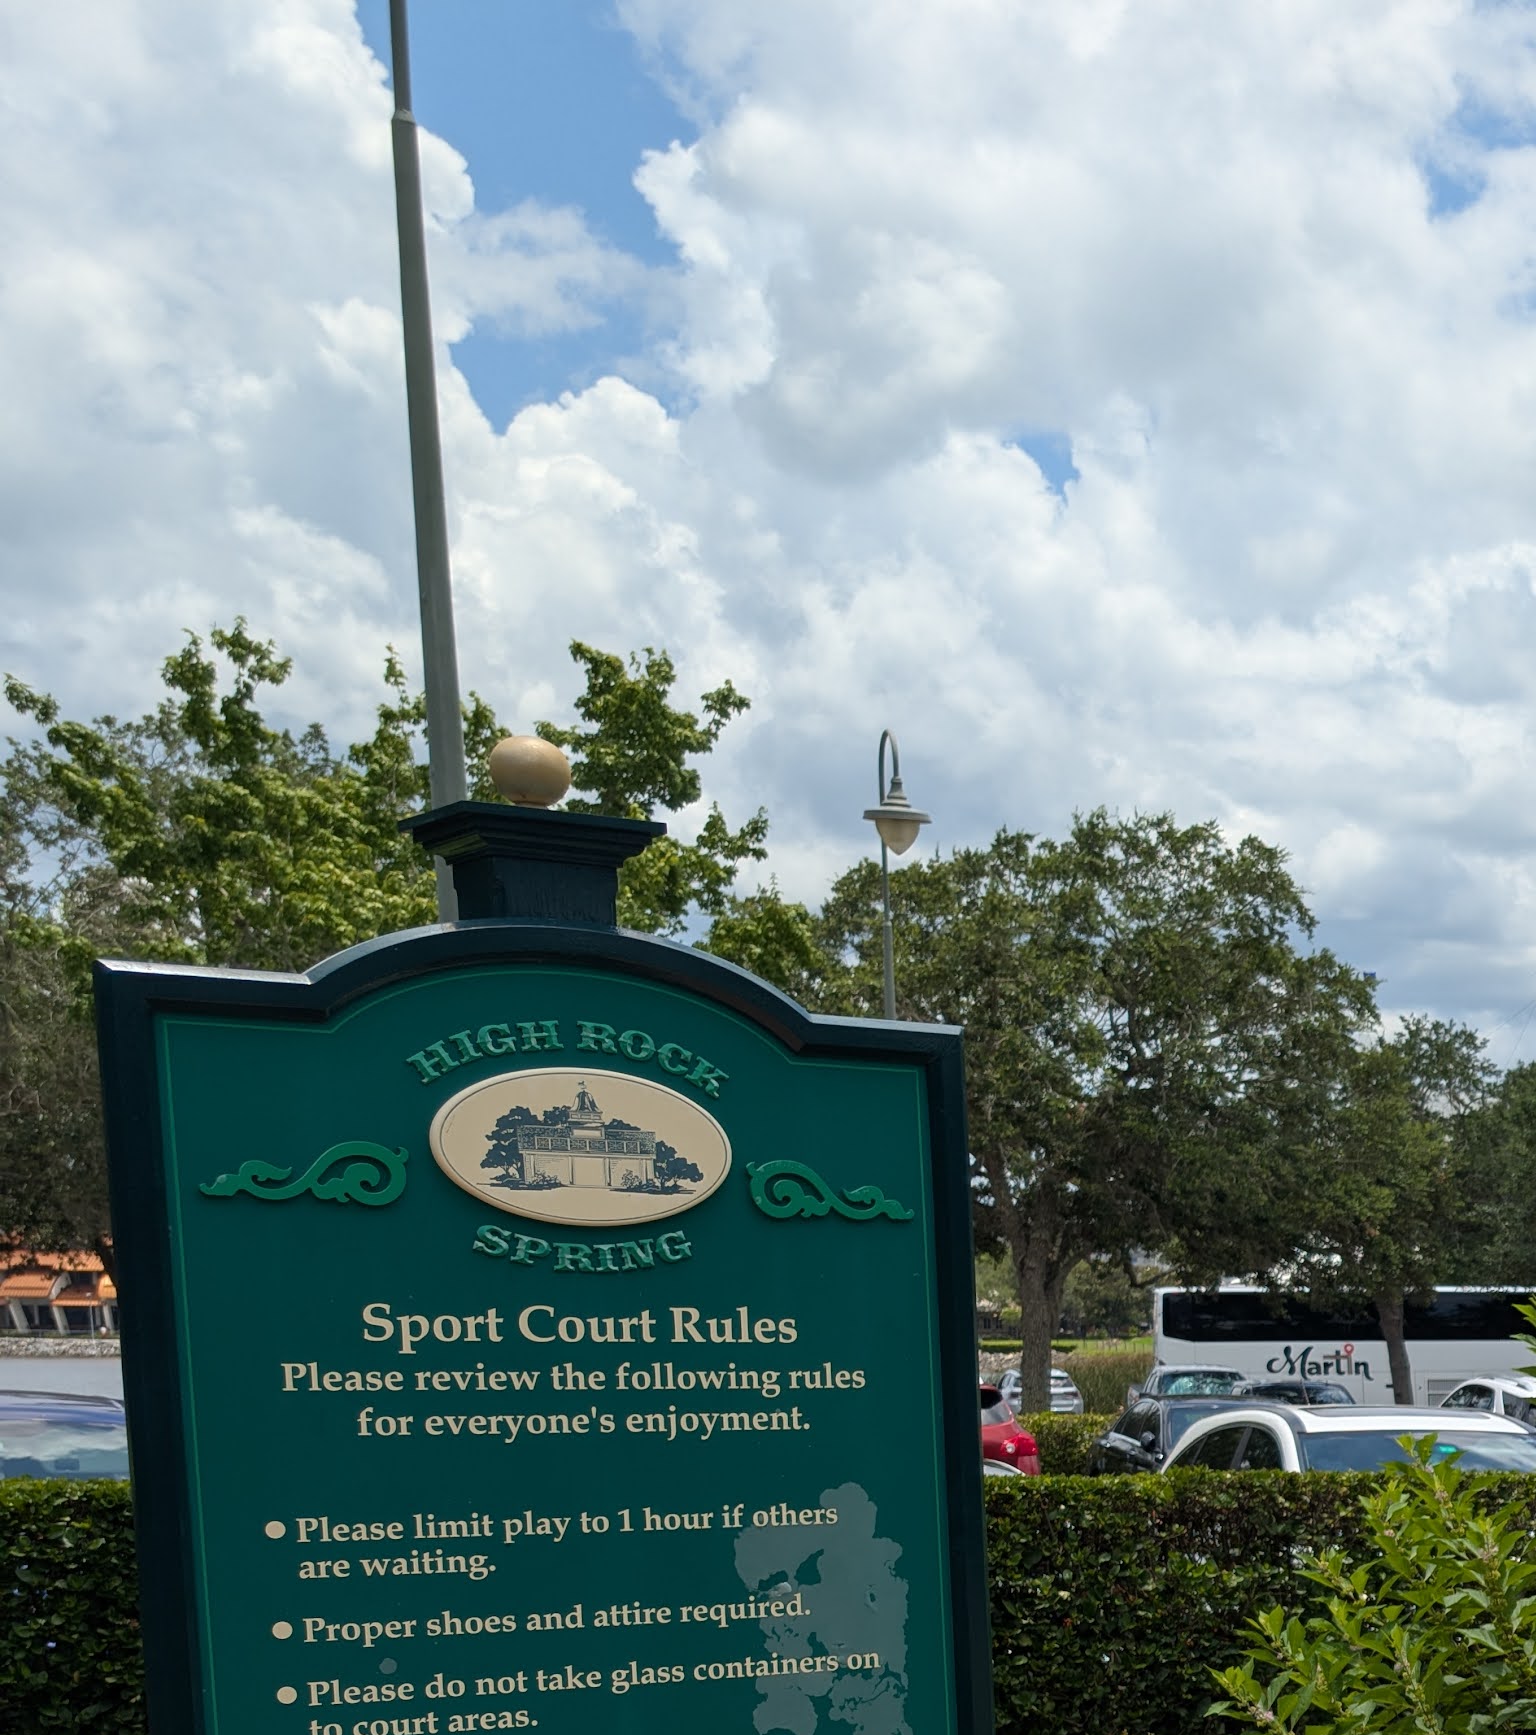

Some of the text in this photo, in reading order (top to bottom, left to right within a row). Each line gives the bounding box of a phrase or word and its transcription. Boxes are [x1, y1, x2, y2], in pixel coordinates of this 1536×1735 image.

[405, 1020, 730, 1099] HIGH ROCK
[472, 1224, 694, 1273] SPRING
[361, 1303, 798, 1355] Sport Court Rules
[281, 1362, 866, 1398] Please review the following rules
[1266, 1344, 1374, 1381] Martin
[357, 1406, 810, 1443] for everyone's enjoyment.
[296, 1503, 839, 1544] Please limit play to 1 hour if others
[297, 1549, 496, 1580] are waiting.
[302, 1591, 811, 1648] Proper shoes and attire required.
[306, 1651, 881, 1706] Please do not take glass containers on
[446, 1710, 538, 1732] areas.
